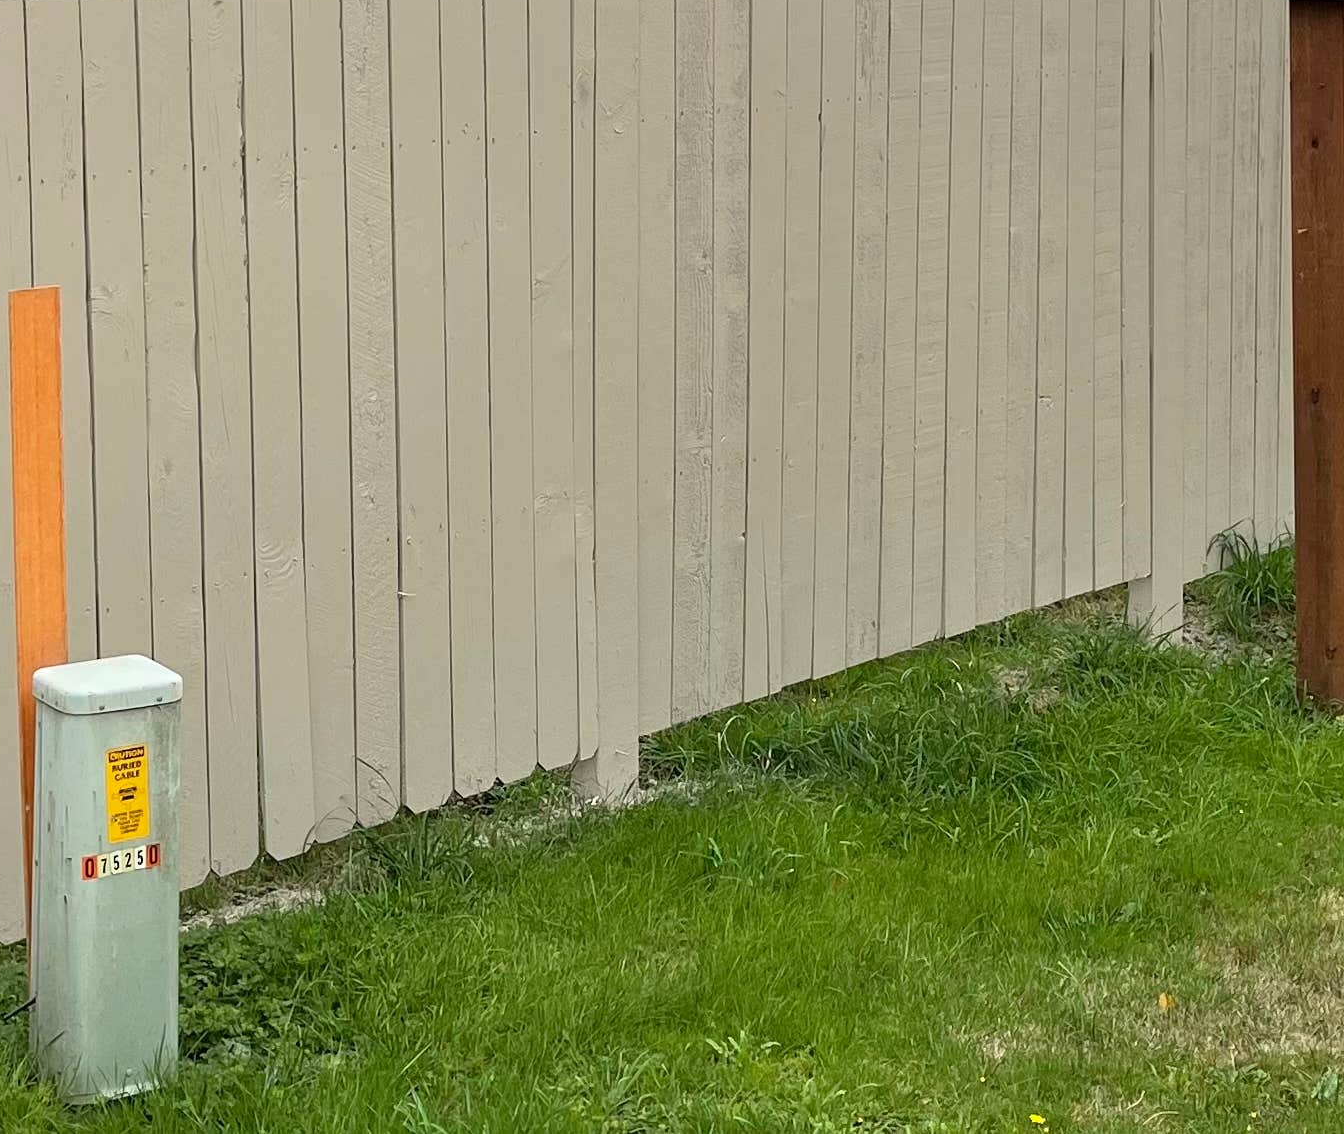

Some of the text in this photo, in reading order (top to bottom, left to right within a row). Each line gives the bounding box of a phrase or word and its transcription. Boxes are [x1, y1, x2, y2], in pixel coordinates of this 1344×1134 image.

[109, 748, 144, 762] CAUTION
[112, 761, 142, 772] BURIED
[114, 769, 140, 781] CABLE
